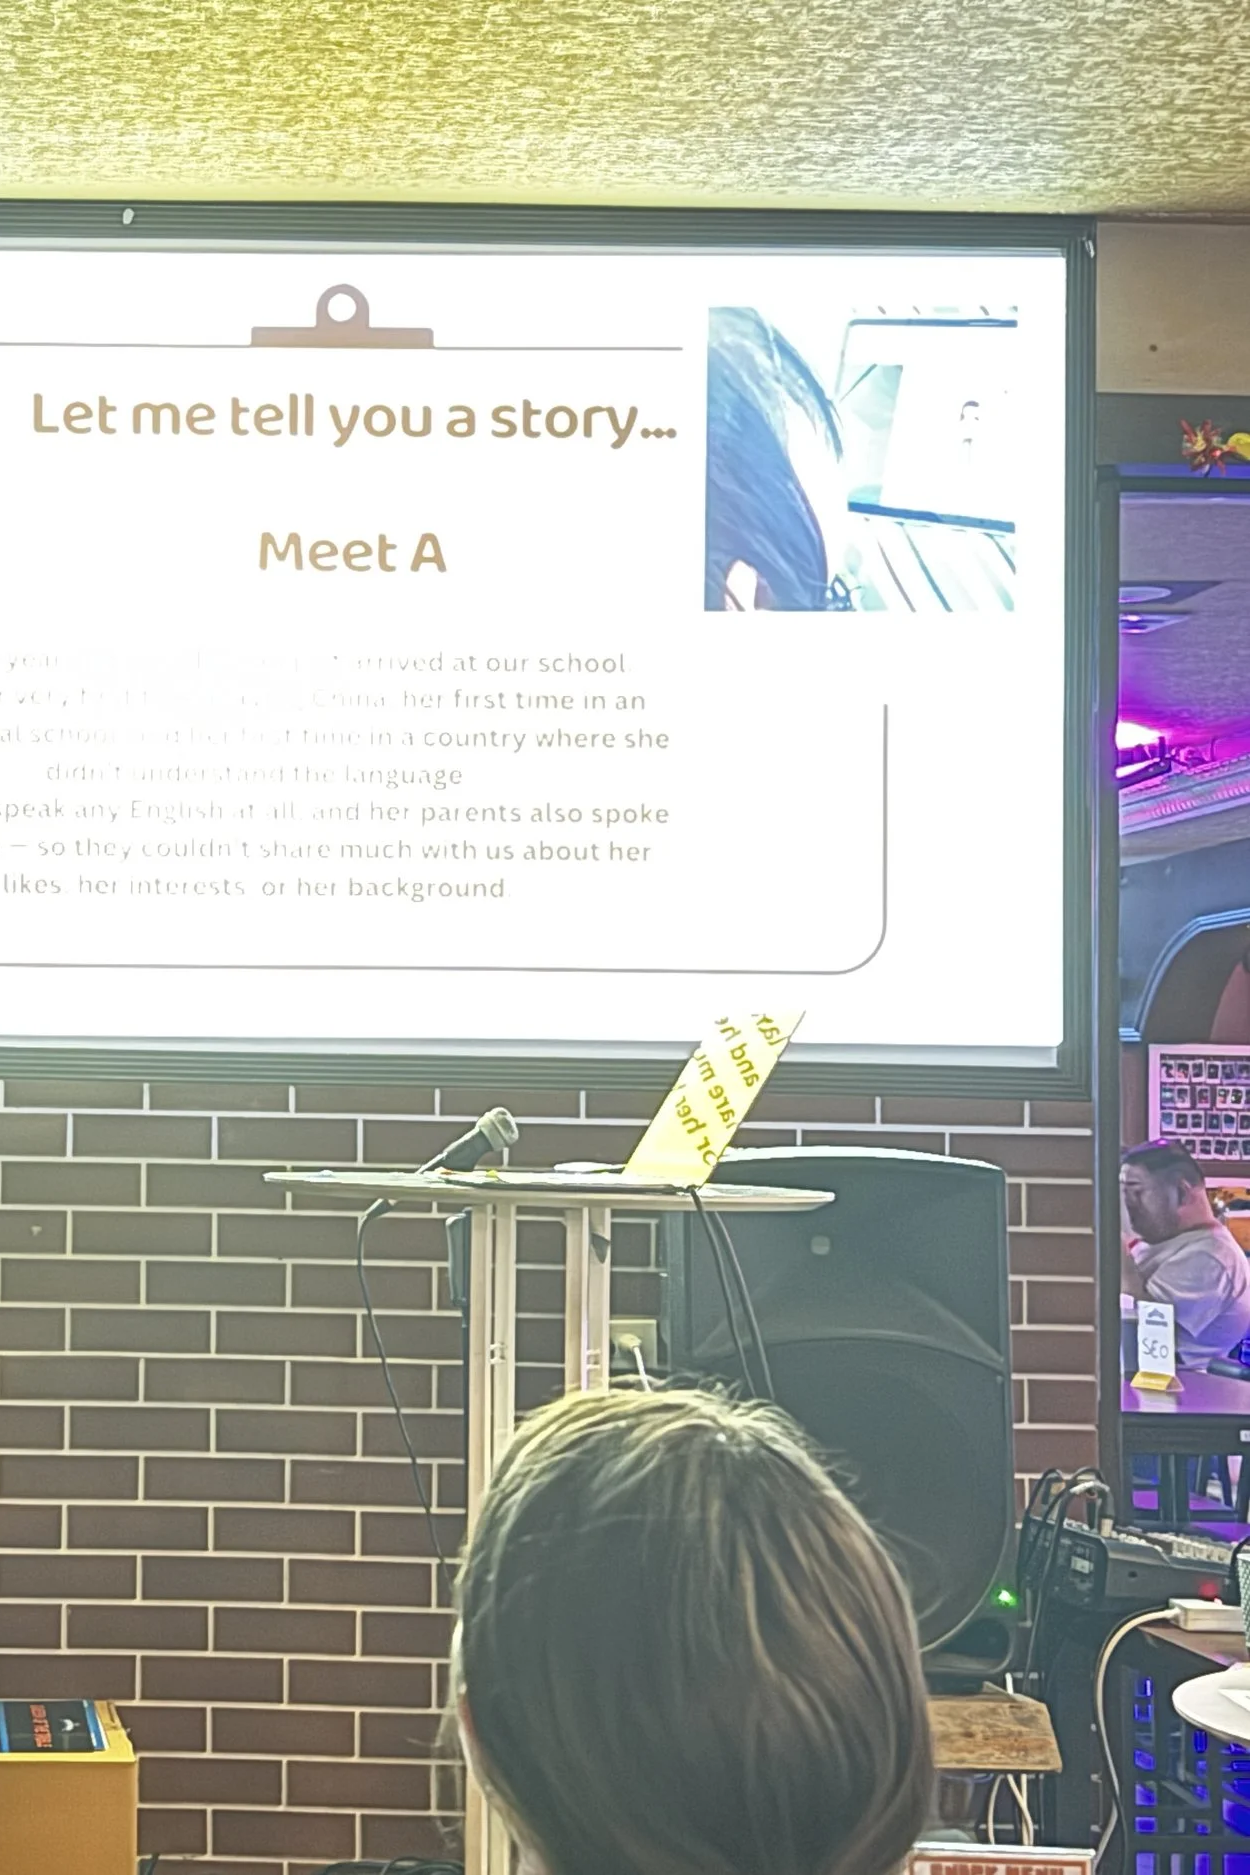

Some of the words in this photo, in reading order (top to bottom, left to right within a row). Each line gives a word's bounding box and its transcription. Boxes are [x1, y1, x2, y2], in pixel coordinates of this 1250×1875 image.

[33, 393, 117, 436] Let
[131, 402, 217, 436] me
[230, 393, 315, 437] tell
[329, 403, 433, 448] you
[445, 403, 477, 438] a
[490, 398, 678, 450] story...
[259, 532, 398, 573] Meet
[409, 532, 448, 573] A
[450, 654, 479, 673] at
[486, 655, 530, 673] our
[402, 688, 445, 710] her
[454, 688, 507, 711] first
[515, 690, 576, 711] time
[582, 691, 607, 712] in
[615, 694, 647, 712] an
[370, 726, 393, 747] in
[401, 732, 415, 747] a
[423, 729, 527, 752] country
[535, 729, 617, 749] where
[624, 729, 670, 750] she
[74, 801, 121, 824] any
[131, 800, 223, 825] English
[312, 801, 360, 822] and
[370, 801, 411, 823] her
[421, 804, 522, 828] parents
[530, 802, 583, 825] also
[592, 803, 670, 828] spoke
[37, 840, 66, 857] so
[74, 837, 132, 864] they
[260, 839, 331, 860] share
[340, 839, 412, 860] much
[421, 839, 477, 861] with
[486, 844, 515, 861] us
[523, 839, 601, 864] about
[607, 841, 652, 863] her
[79, 873, 118, 895] her
[261, 880, 286, 897] or
[297, 877, 338, 897] her
[1141, 1336, 1170, 1359] SEO
